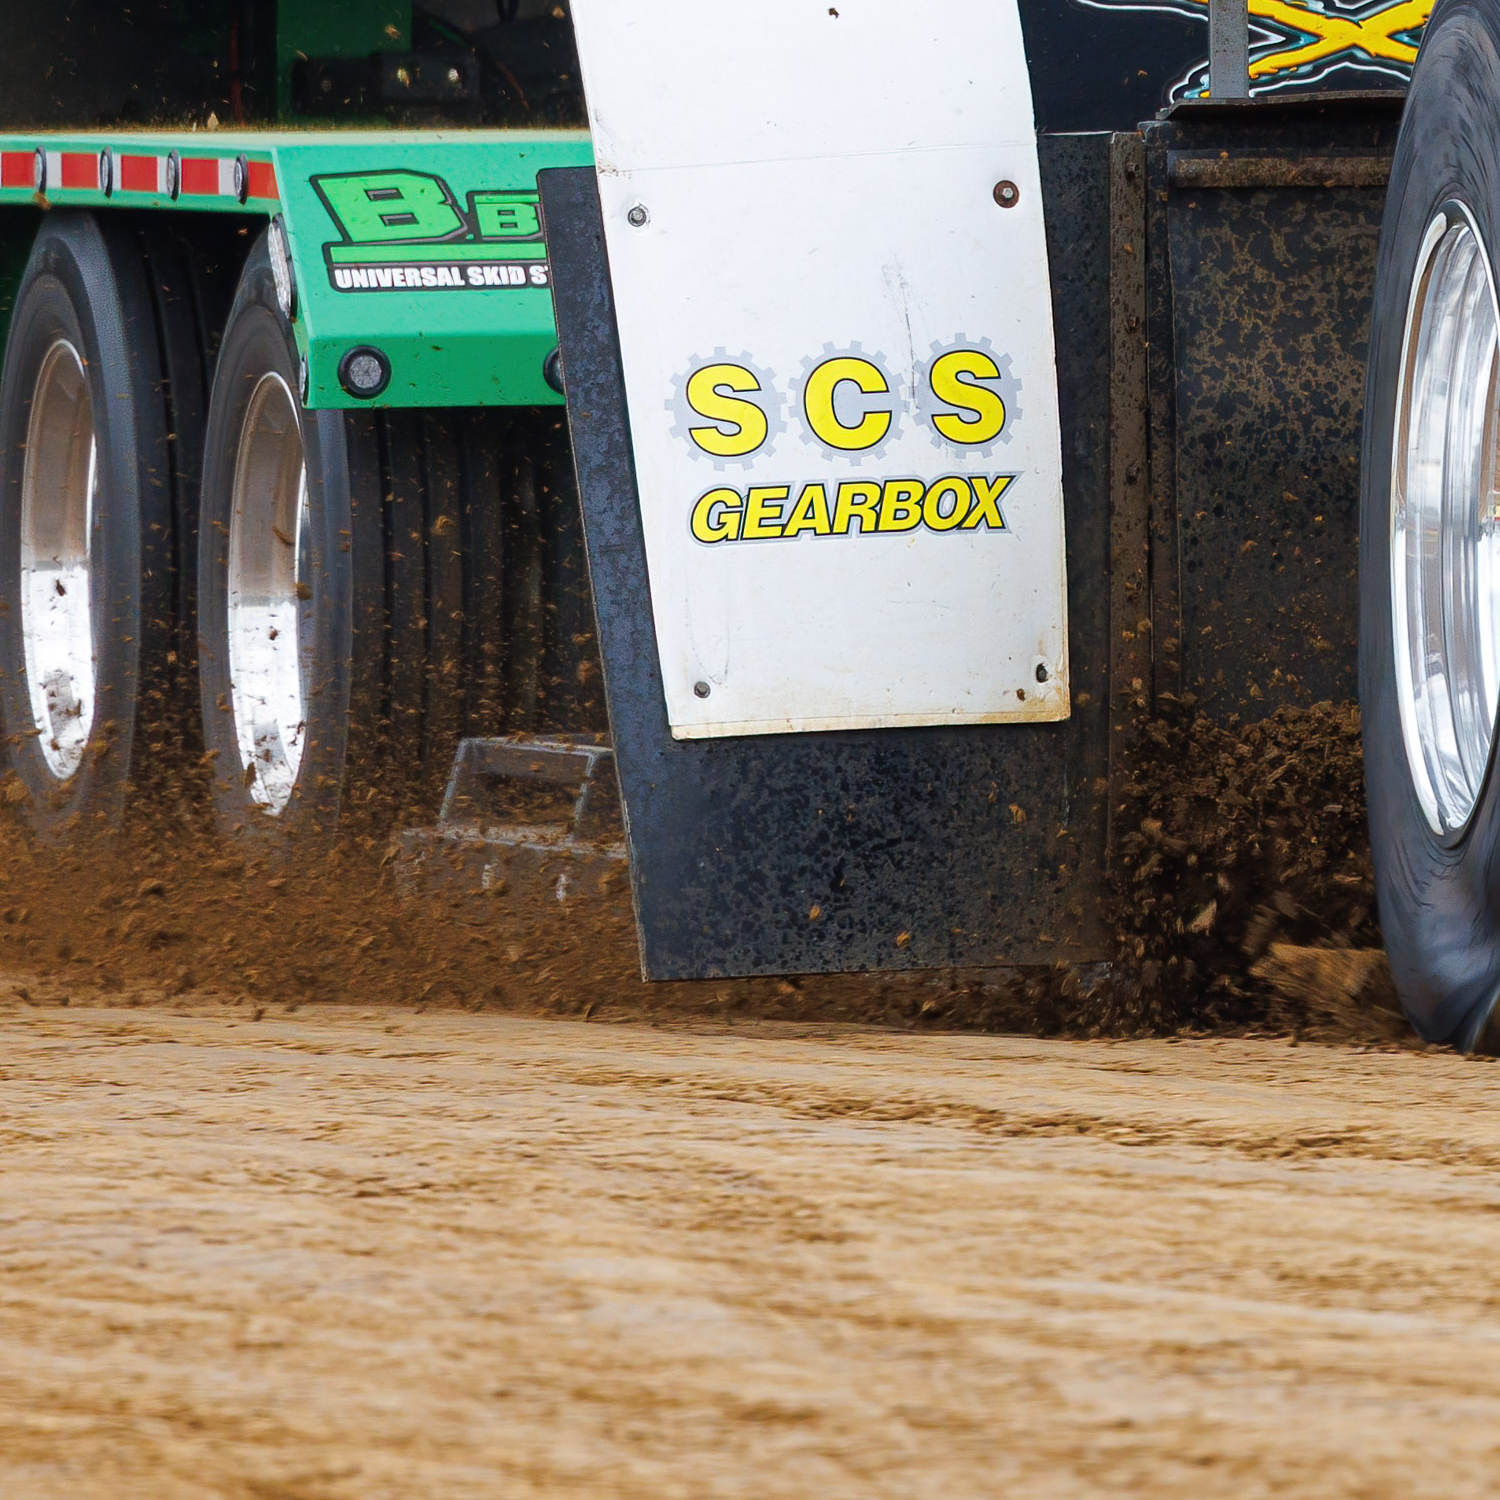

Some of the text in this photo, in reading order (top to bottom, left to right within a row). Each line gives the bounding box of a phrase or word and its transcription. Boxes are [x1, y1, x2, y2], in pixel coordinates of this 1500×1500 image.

[334, 267, 465, 289] UNIVERSAL
[466, 265, 526, 287] SKID
[689, 475, 1016, 544] GEARBOX
